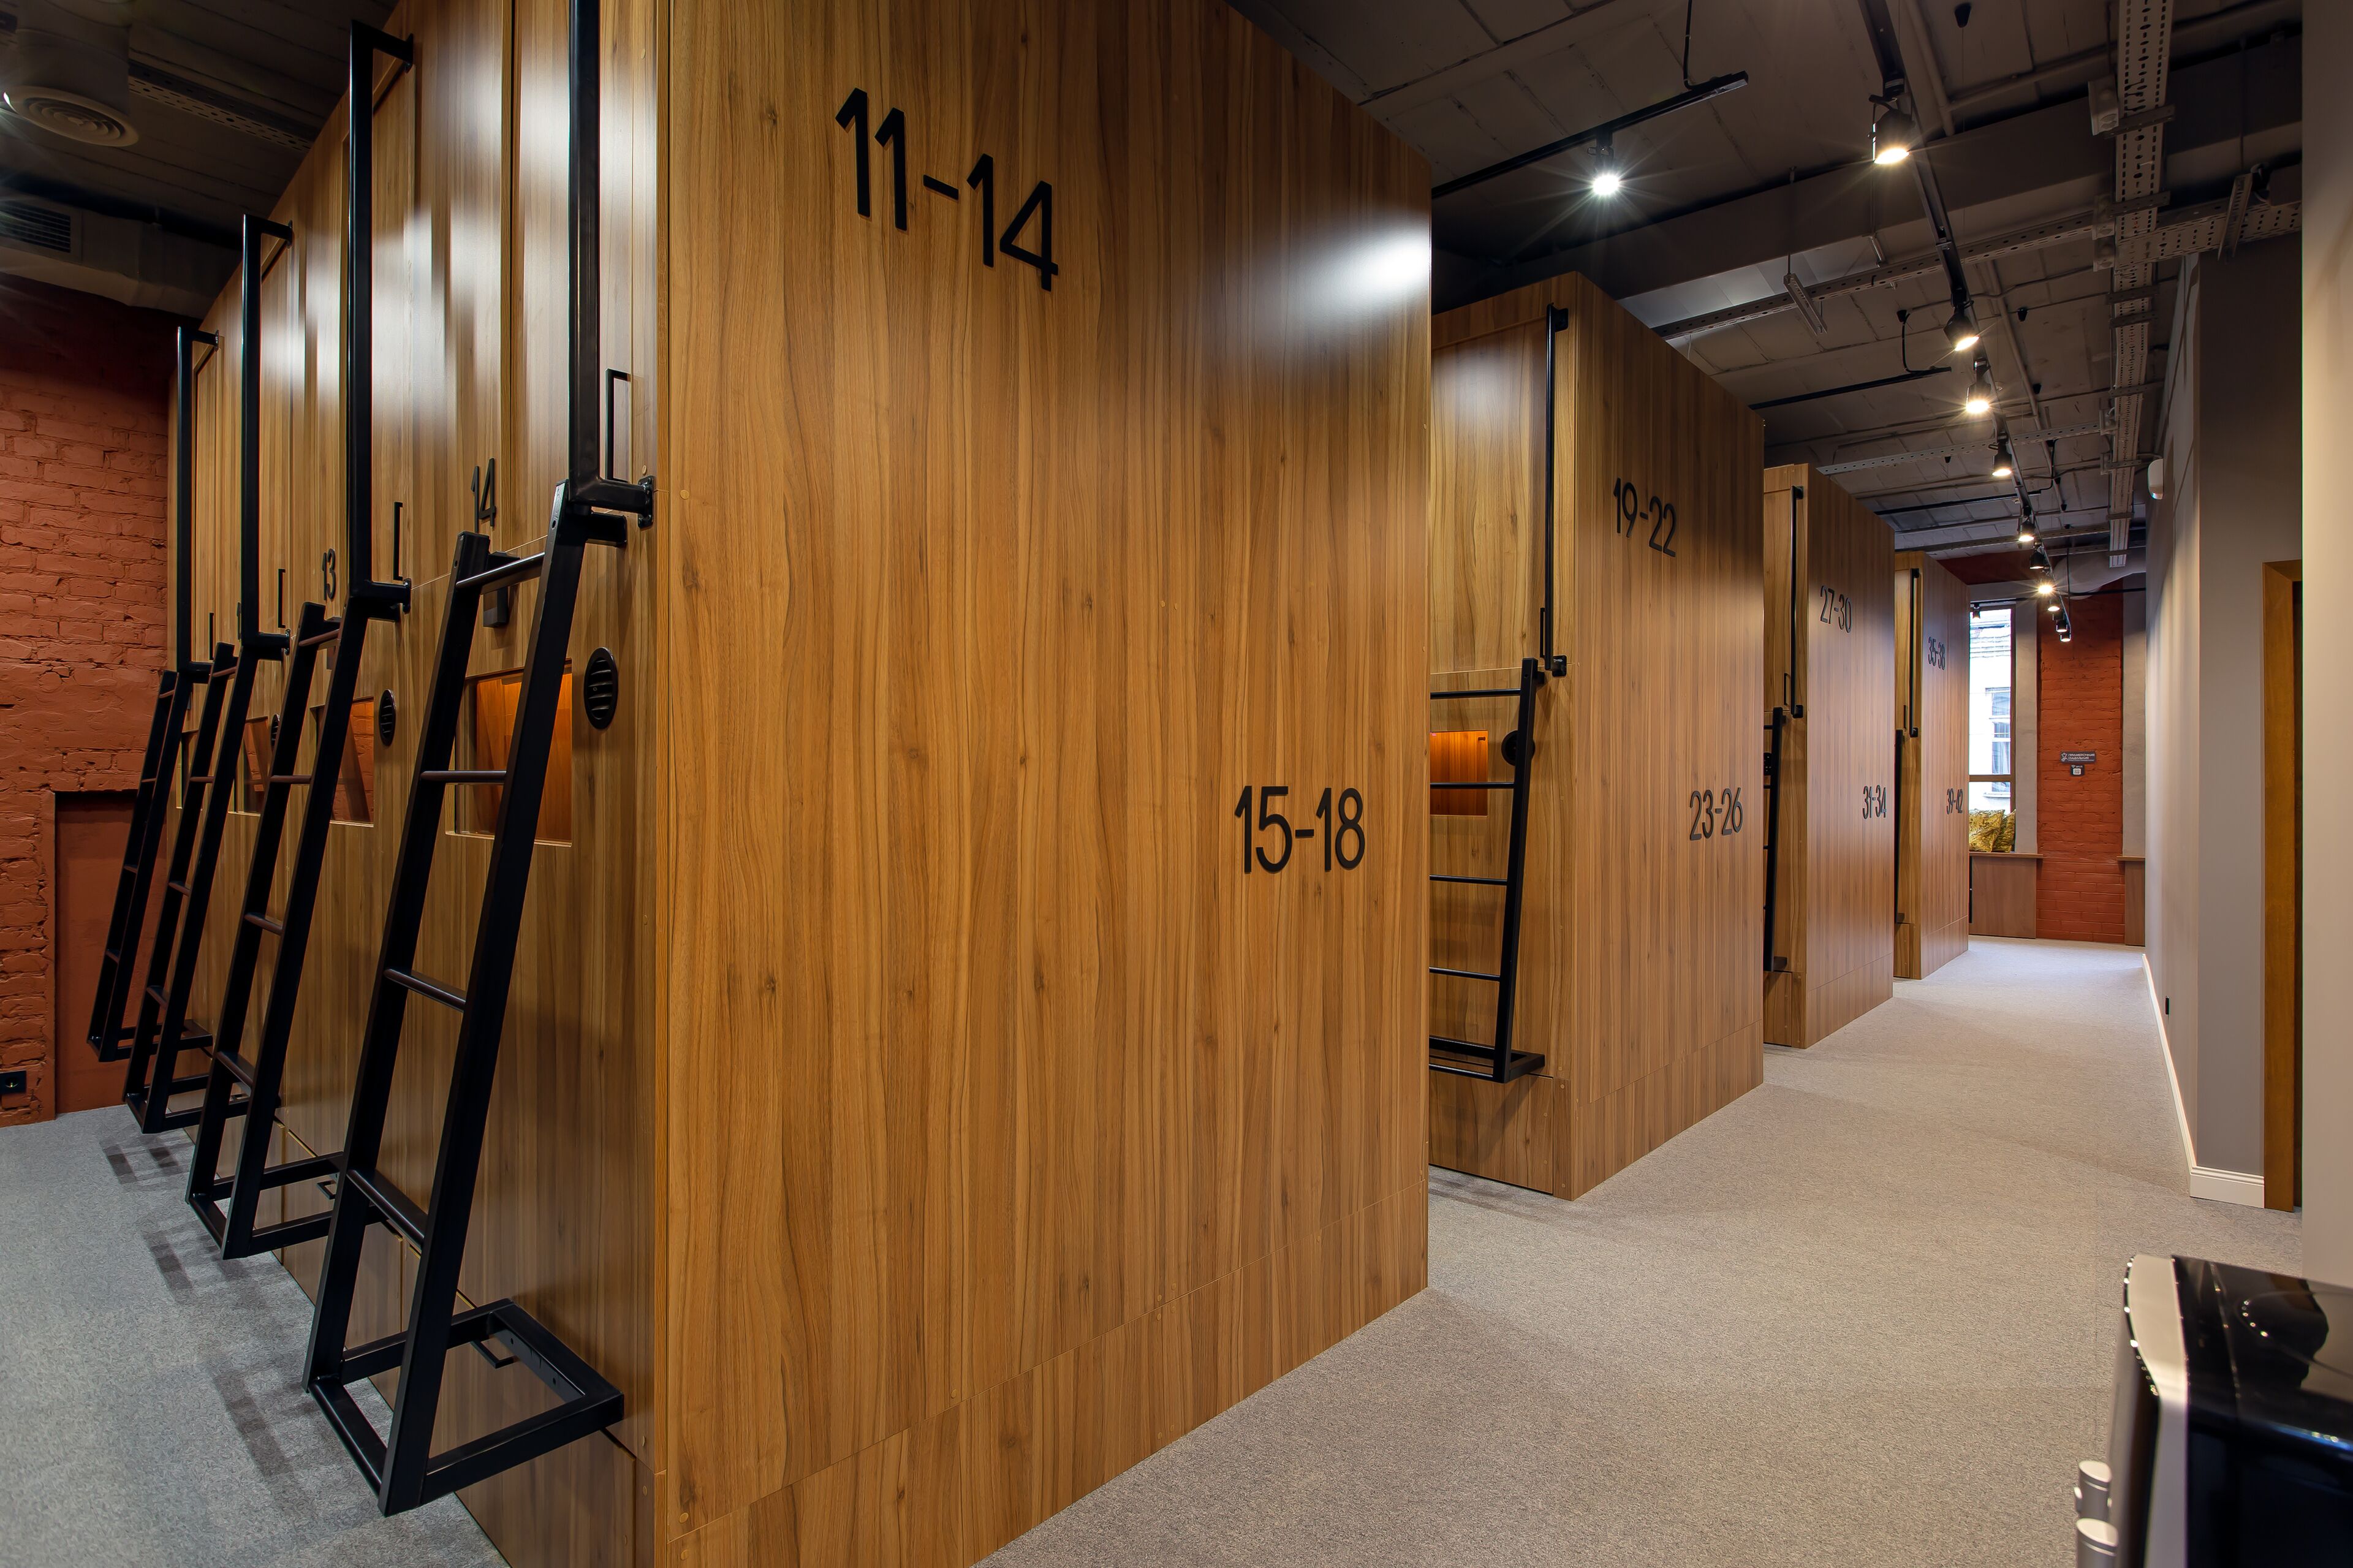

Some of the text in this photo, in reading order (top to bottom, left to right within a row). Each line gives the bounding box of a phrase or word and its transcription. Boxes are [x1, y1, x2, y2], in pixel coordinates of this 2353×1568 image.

[835, 88, 1059, 292] 11-14
[471, 458, 497, 534] 14
[1613, 477, 1677, 558] 19-22
[322, 548, 336, 602] 13
[1820, 585, 1852, 634] 27-30
[1928, 636, 1946, 670] 35-38
[1689, 787, 1743, 841] 23-26
[1862, 784, 1887, 819] 31-34
[1946, 788, 1963, 815] 39-42
[1234, 786, 1365, 874] 15-18
